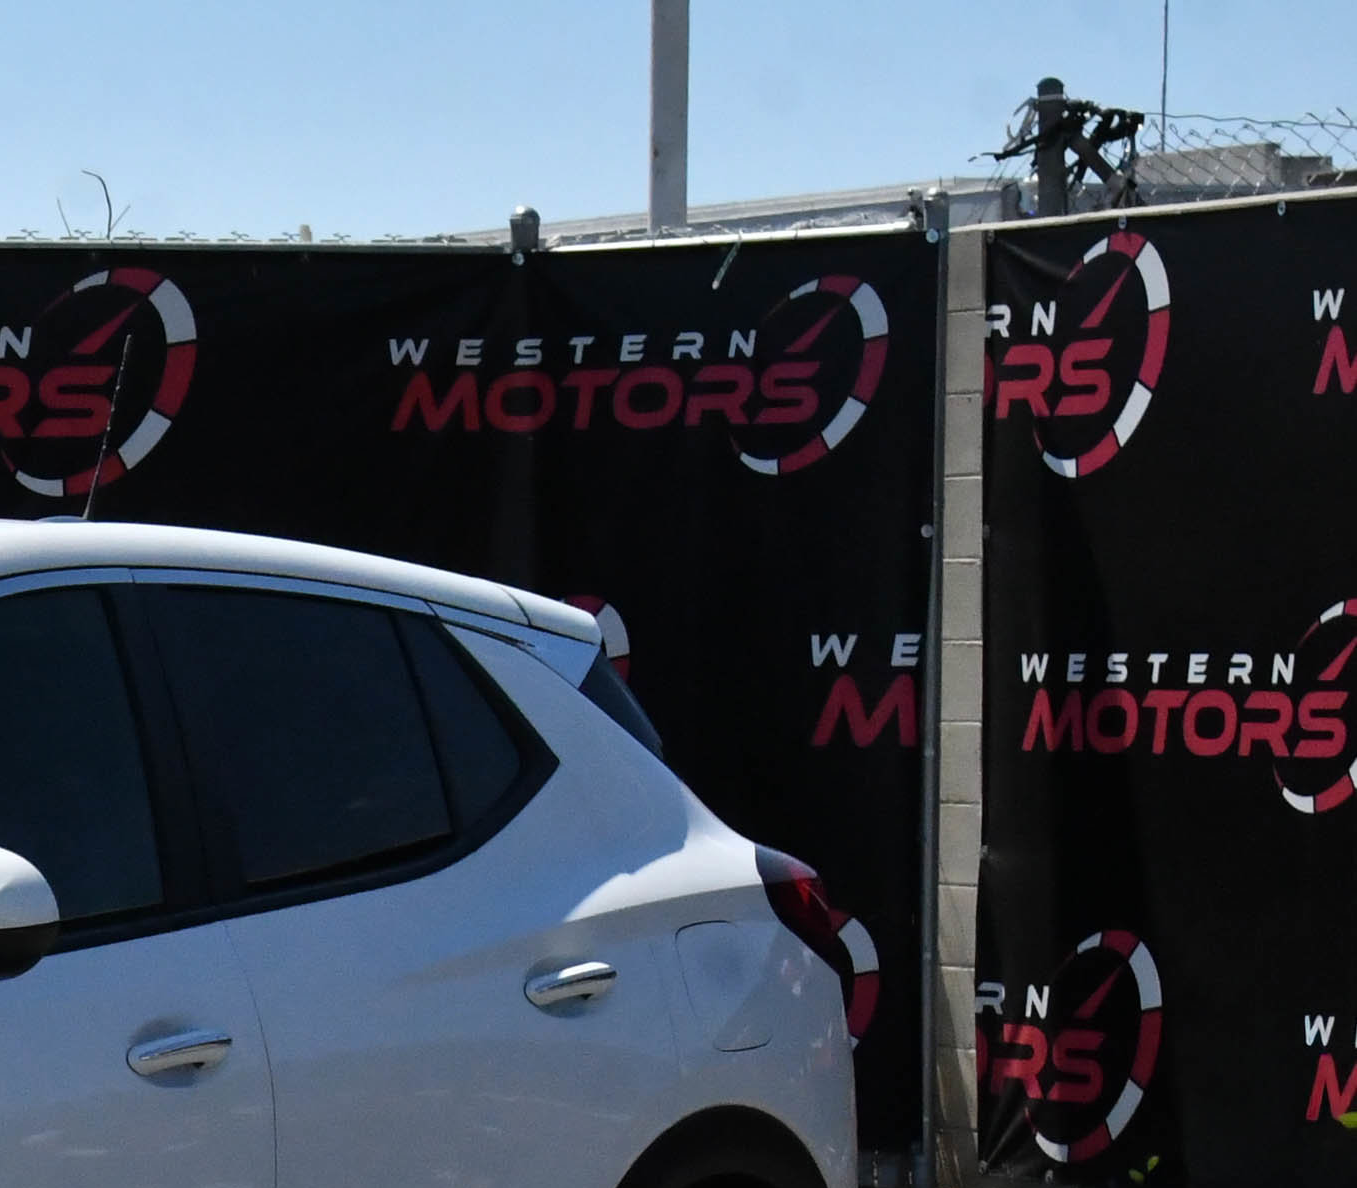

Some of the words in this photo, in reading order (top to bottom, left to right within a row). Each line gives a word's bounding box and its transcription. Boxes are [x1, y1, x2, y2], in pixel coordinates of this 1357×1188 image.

[389, 328, 757, 366] WESTERN
[391, 360, 821, 433] MOTORS
[1021, 653, 1295, 685] WESTERN
[1022, 687, 1350, 759] MOTORS
